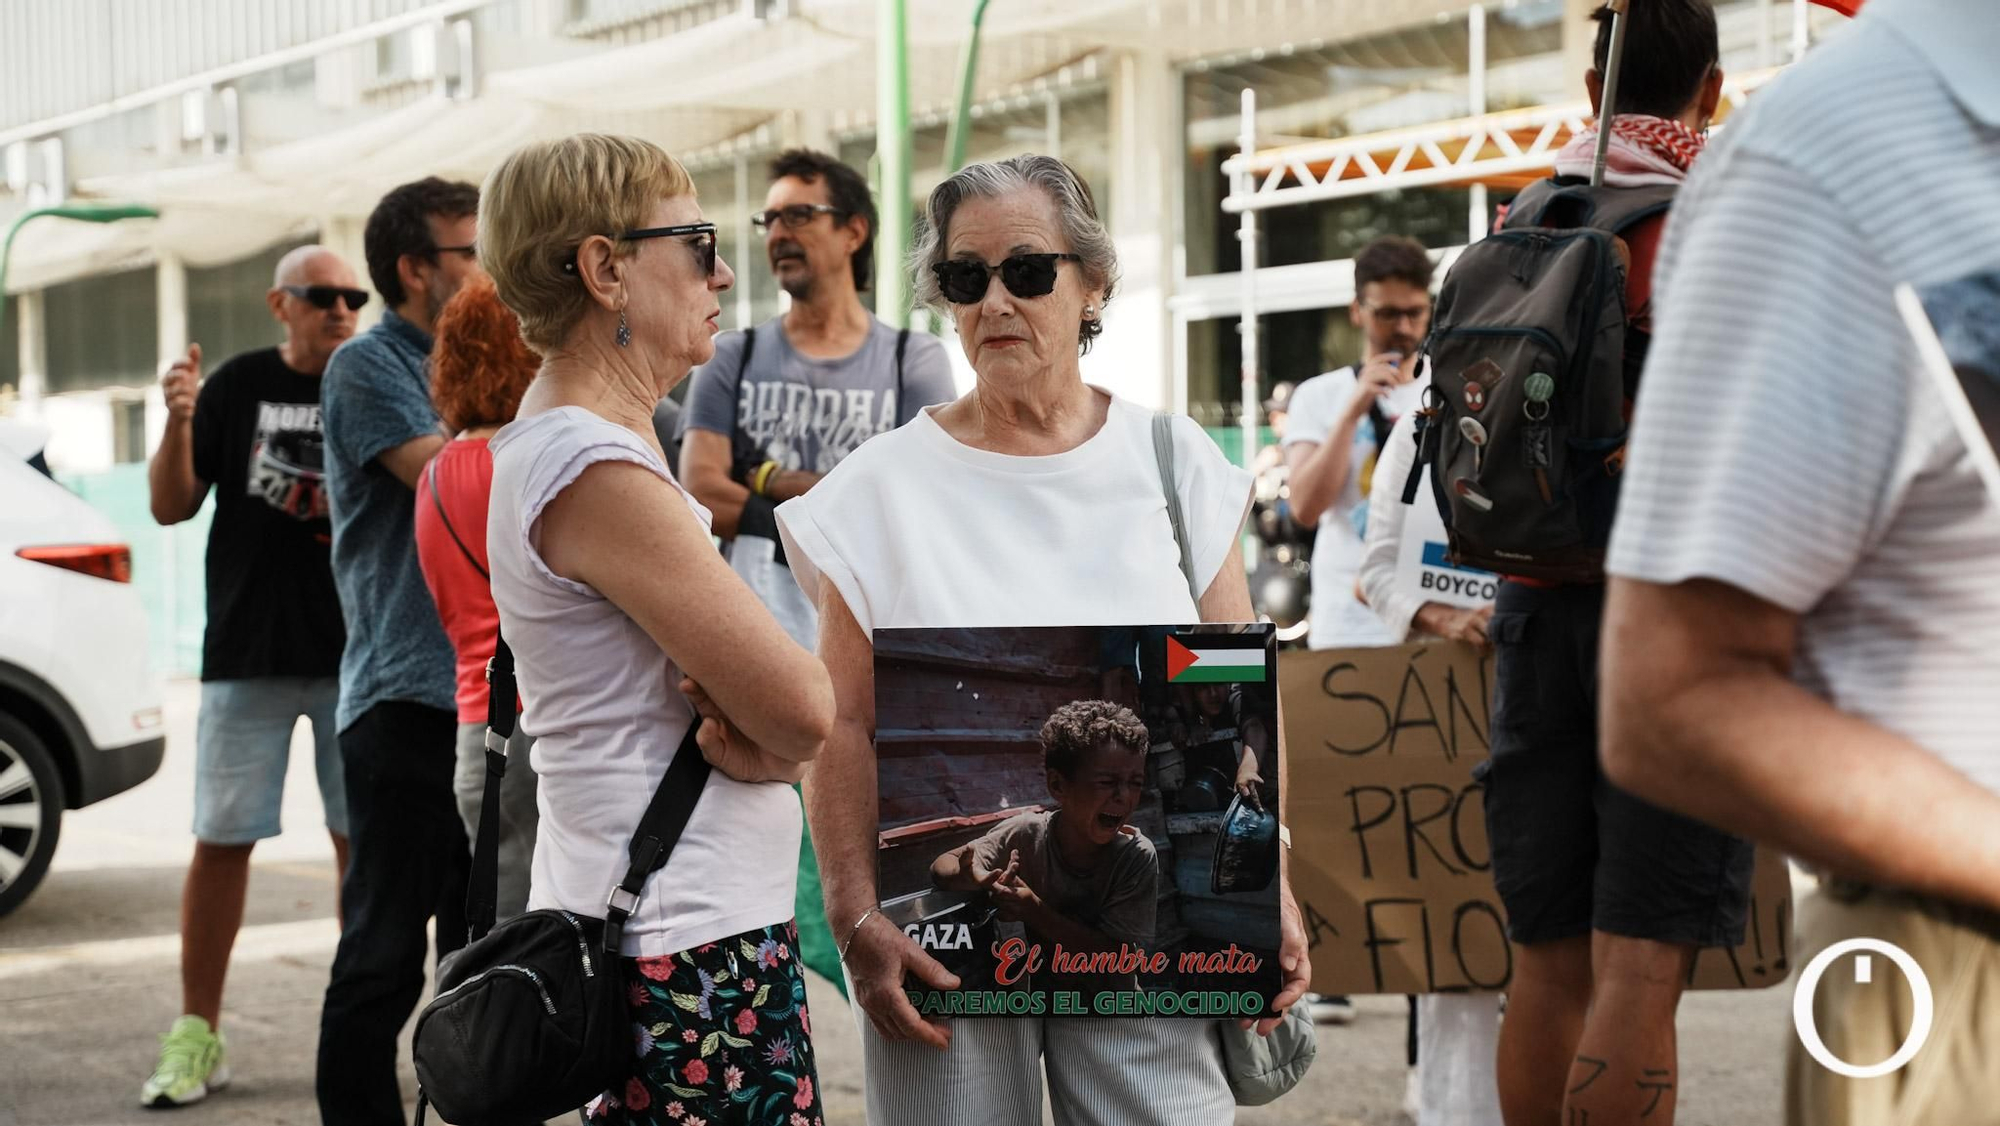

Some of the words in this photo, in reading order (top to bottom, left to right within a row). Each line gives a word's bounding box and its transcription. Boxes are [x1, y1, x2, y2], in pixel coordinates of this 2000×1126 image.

[1421, 571, 1502, 600] BOYCO
[903, 923, 974, 950] GAZA
[1304, 901, 1340, 950] A
[991, 937, 1043, 986] El
[1051, 943, 1170, 974] hambre
[1178, 943, 1263, 974] mata
[906, 990, 1047, 1015] PAREMOS
[1052, 991, 1089, 1015] EL
[1093, 990, 1265, 1015] GENOCIDIO
